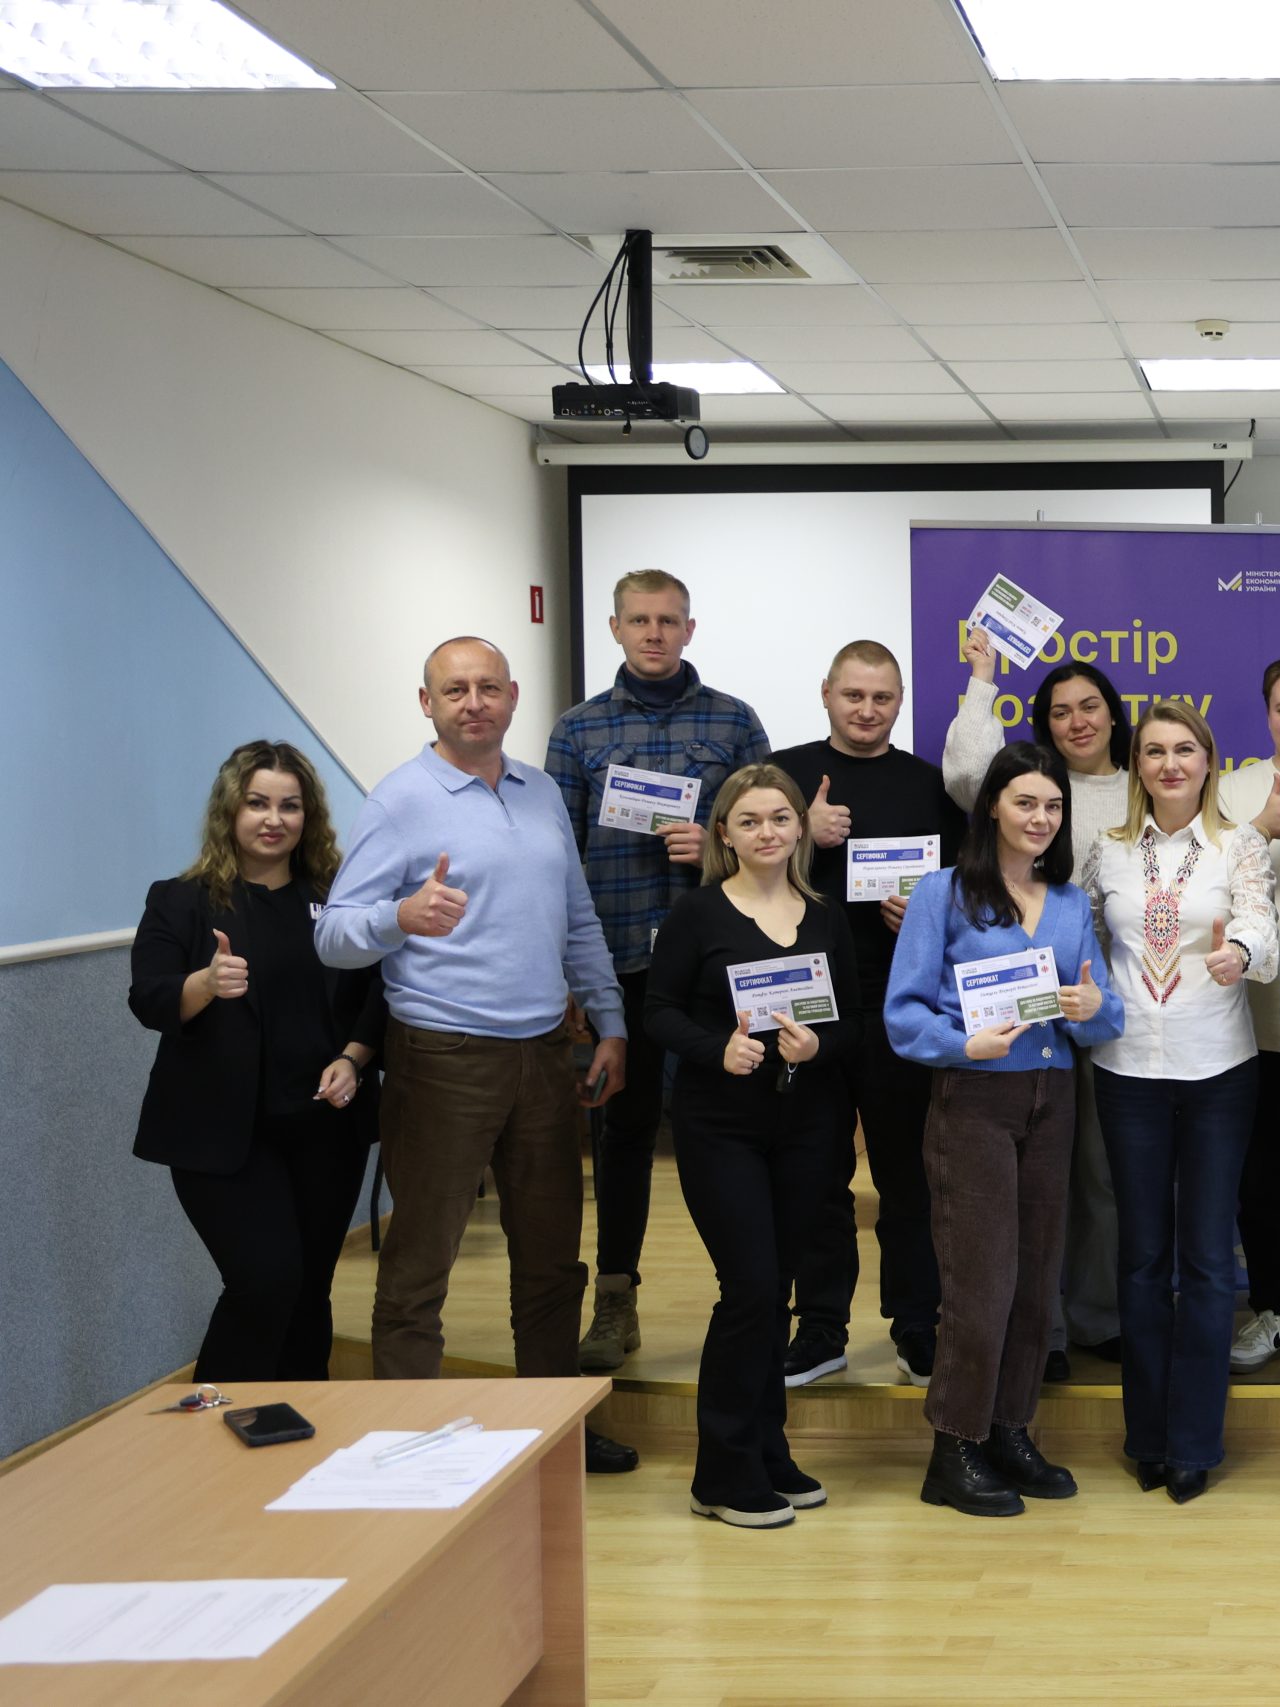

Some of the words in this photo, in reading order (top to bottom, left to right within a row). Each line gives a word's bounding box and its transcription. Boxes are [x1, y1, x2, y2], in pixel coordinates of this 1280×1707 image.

[614, 780, 646, 792] СЕРТИФІКАТ
[856, 852, 887, 860] СЕРТИФІКАТ
[739, 976, 773, 988] СЕРТИФІКАТ
[966, 974, 999, 987] СЕРТИФІКАТ
